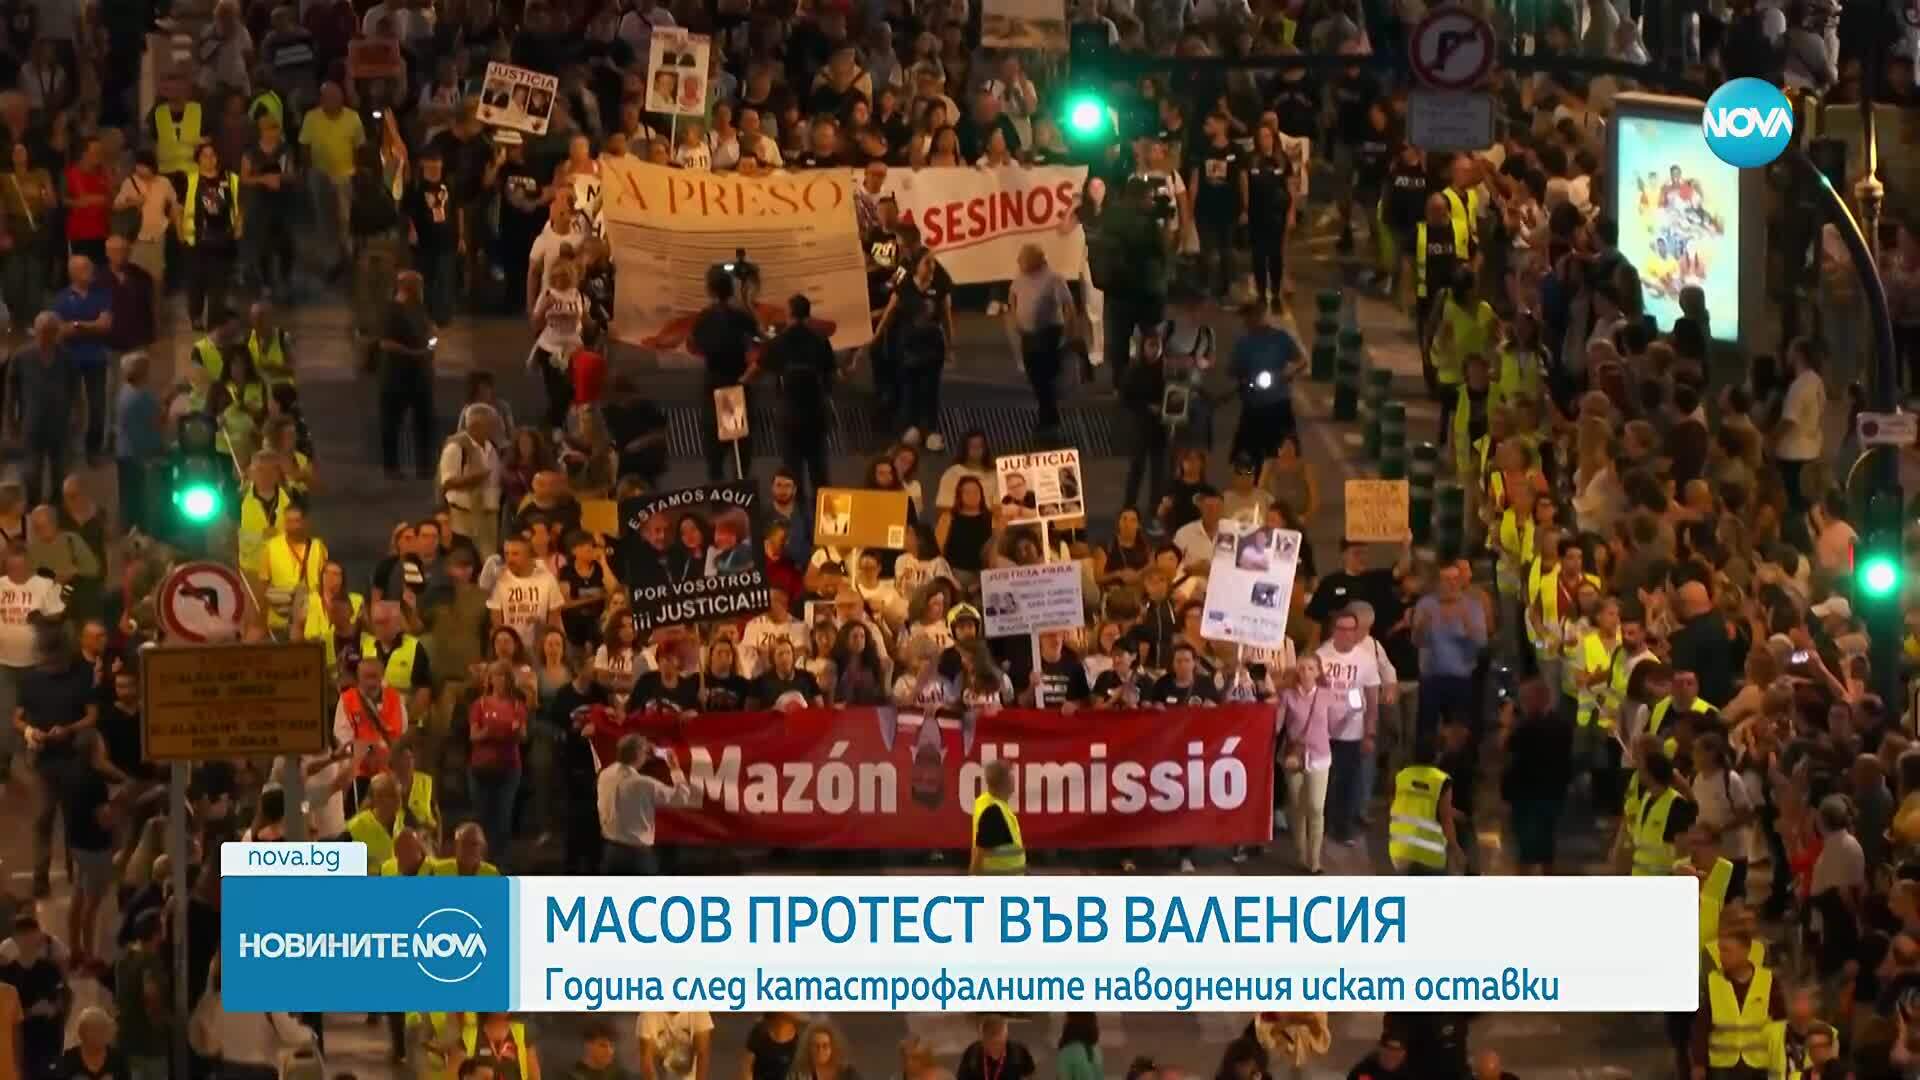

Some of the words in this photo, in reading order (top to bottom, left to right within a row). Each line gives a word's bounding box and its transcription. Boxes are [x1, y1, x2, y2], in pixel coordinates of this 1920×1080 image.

[490, 65, 555, 88] JUSTICIA
[628, 490, 704, 530] ESTAMOS
[710, 489, 754, 507] AQUÍ
[634, 586, 667, 601] POR
[673, 572, 762, 595] VOSOTROS
[656, 590, 768, 623] JUSTICIA!!!
[1327, 663, 1358, 681] 20:11
[690, 741, 898, 814] Mazón
